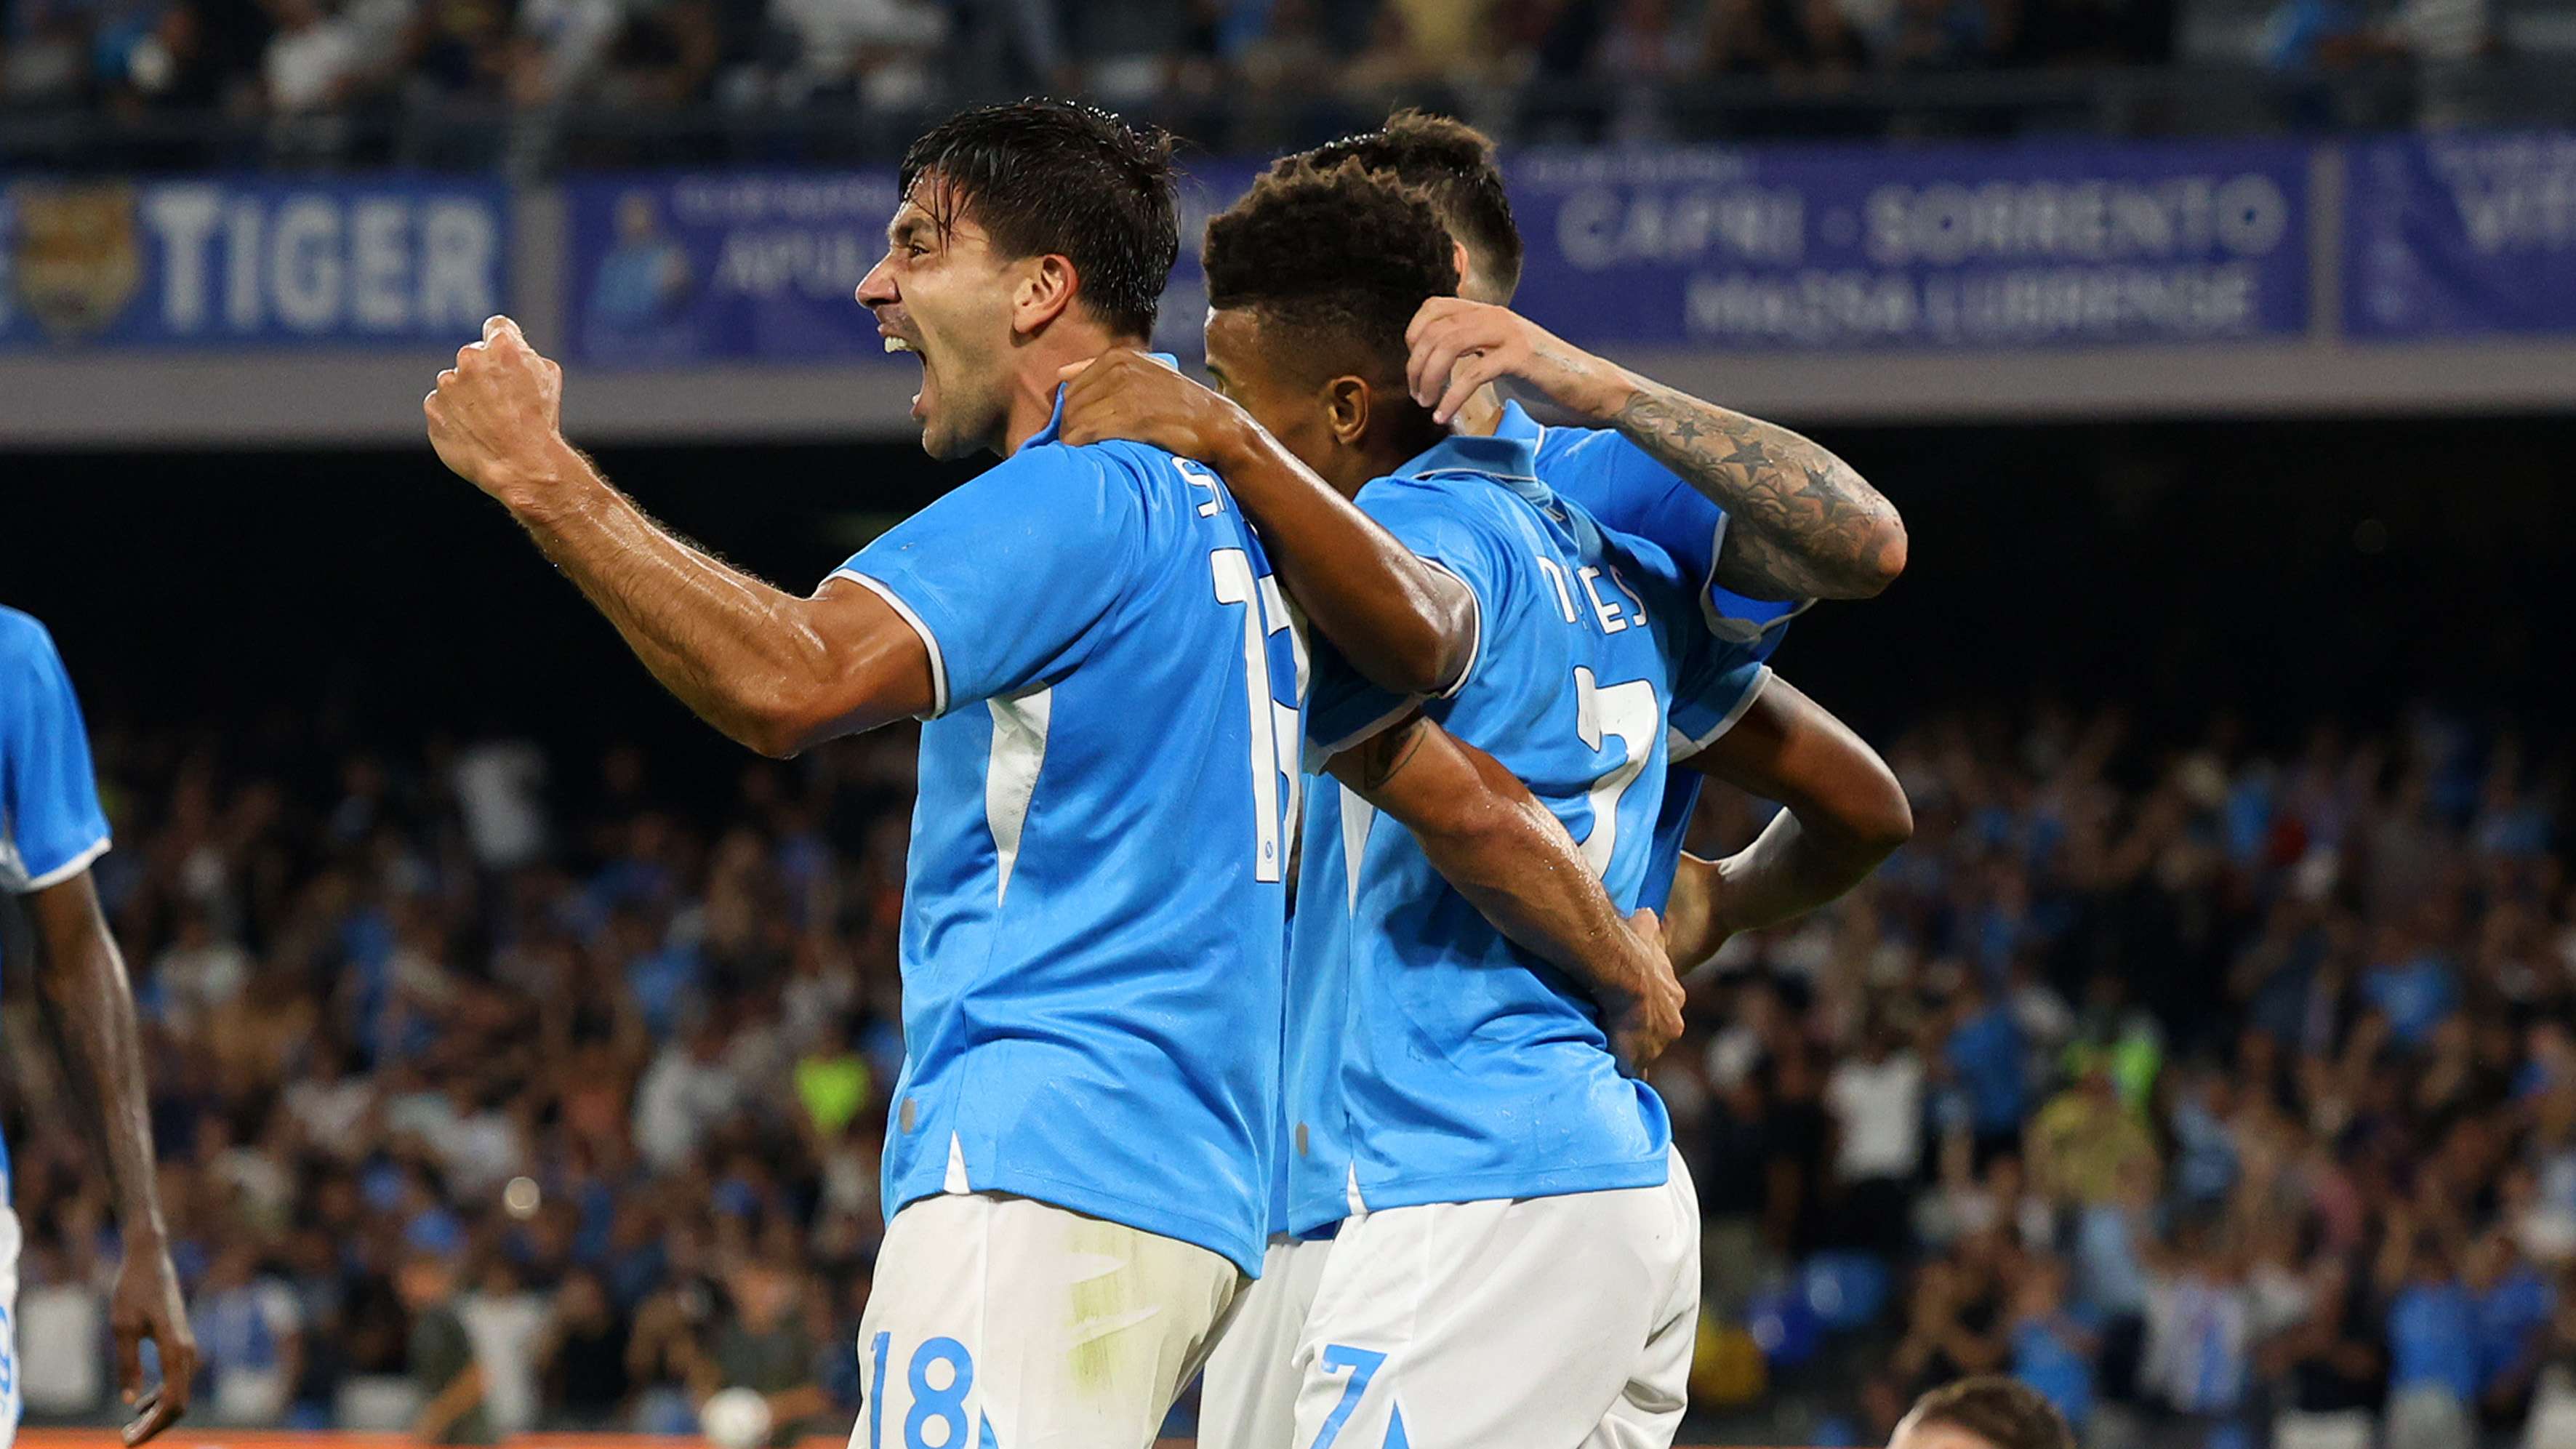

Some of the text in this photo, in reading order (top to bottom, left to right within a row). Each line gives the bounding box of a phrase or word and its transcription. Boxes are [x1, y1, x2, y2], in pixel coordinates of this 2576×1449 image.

[148, 184, 497, 334] TIGER
[1865, 172, 2290, 266] SORRENTO
[1573, 666, 1659, 881] 7
[870, 1331, 974, 1449] 18
[1310, 1344, 1387, 1449] 7
